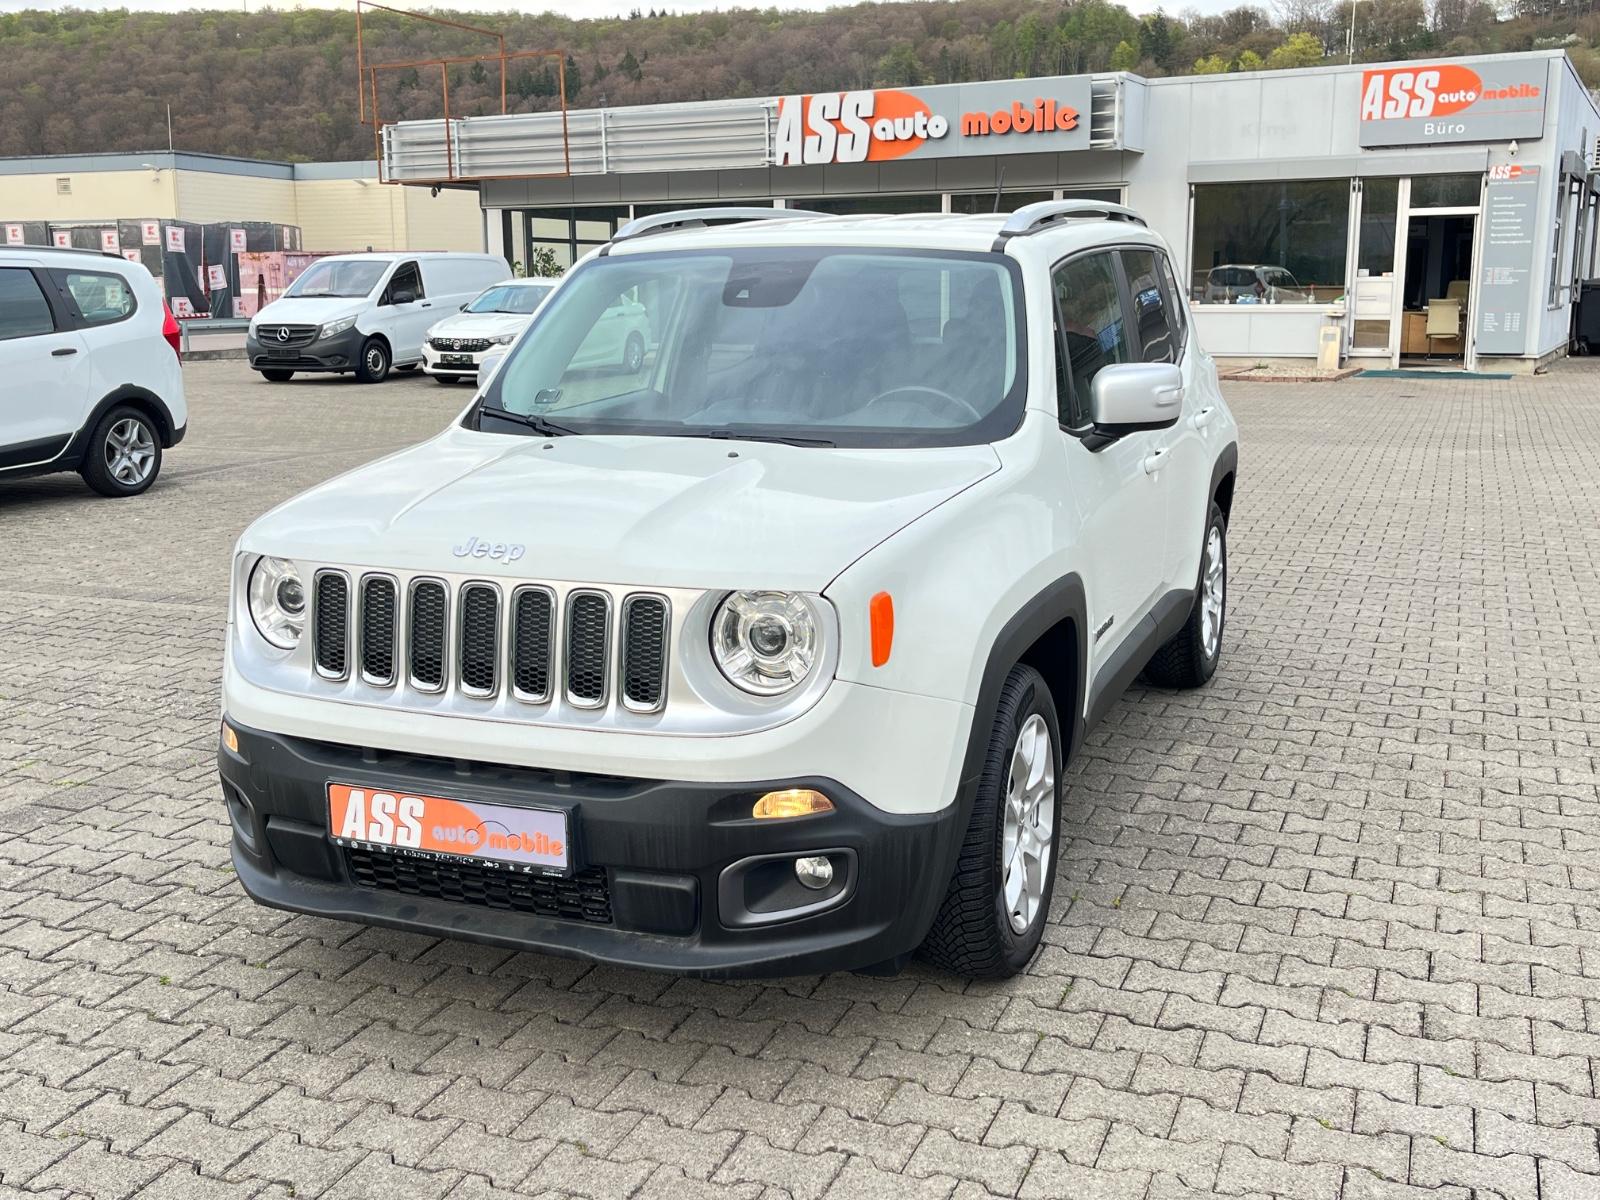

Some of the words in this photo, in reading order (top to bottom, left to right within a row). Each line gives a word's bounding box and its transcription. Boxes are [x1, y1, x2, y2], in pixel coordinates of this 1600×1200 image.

[1362, 70, 1440, 121] ASS
[1438, 89, 1476, 104] auto
[1483, 84, 1540, 100] mobile
[775, 90, 875, 166] ASS
[873, 111, 949, 142] auto
[960, 97, 1080, 137] mobile
[1424, 122, 1466, 136] Büro
[1489, 165, 1512, 180] ASS
[452, 536, 526, 565] Jeep
[341, 789, 425, 849] ASS
[432, 823, 481, 846] auto
[488, 830, 564, 857] mobile
